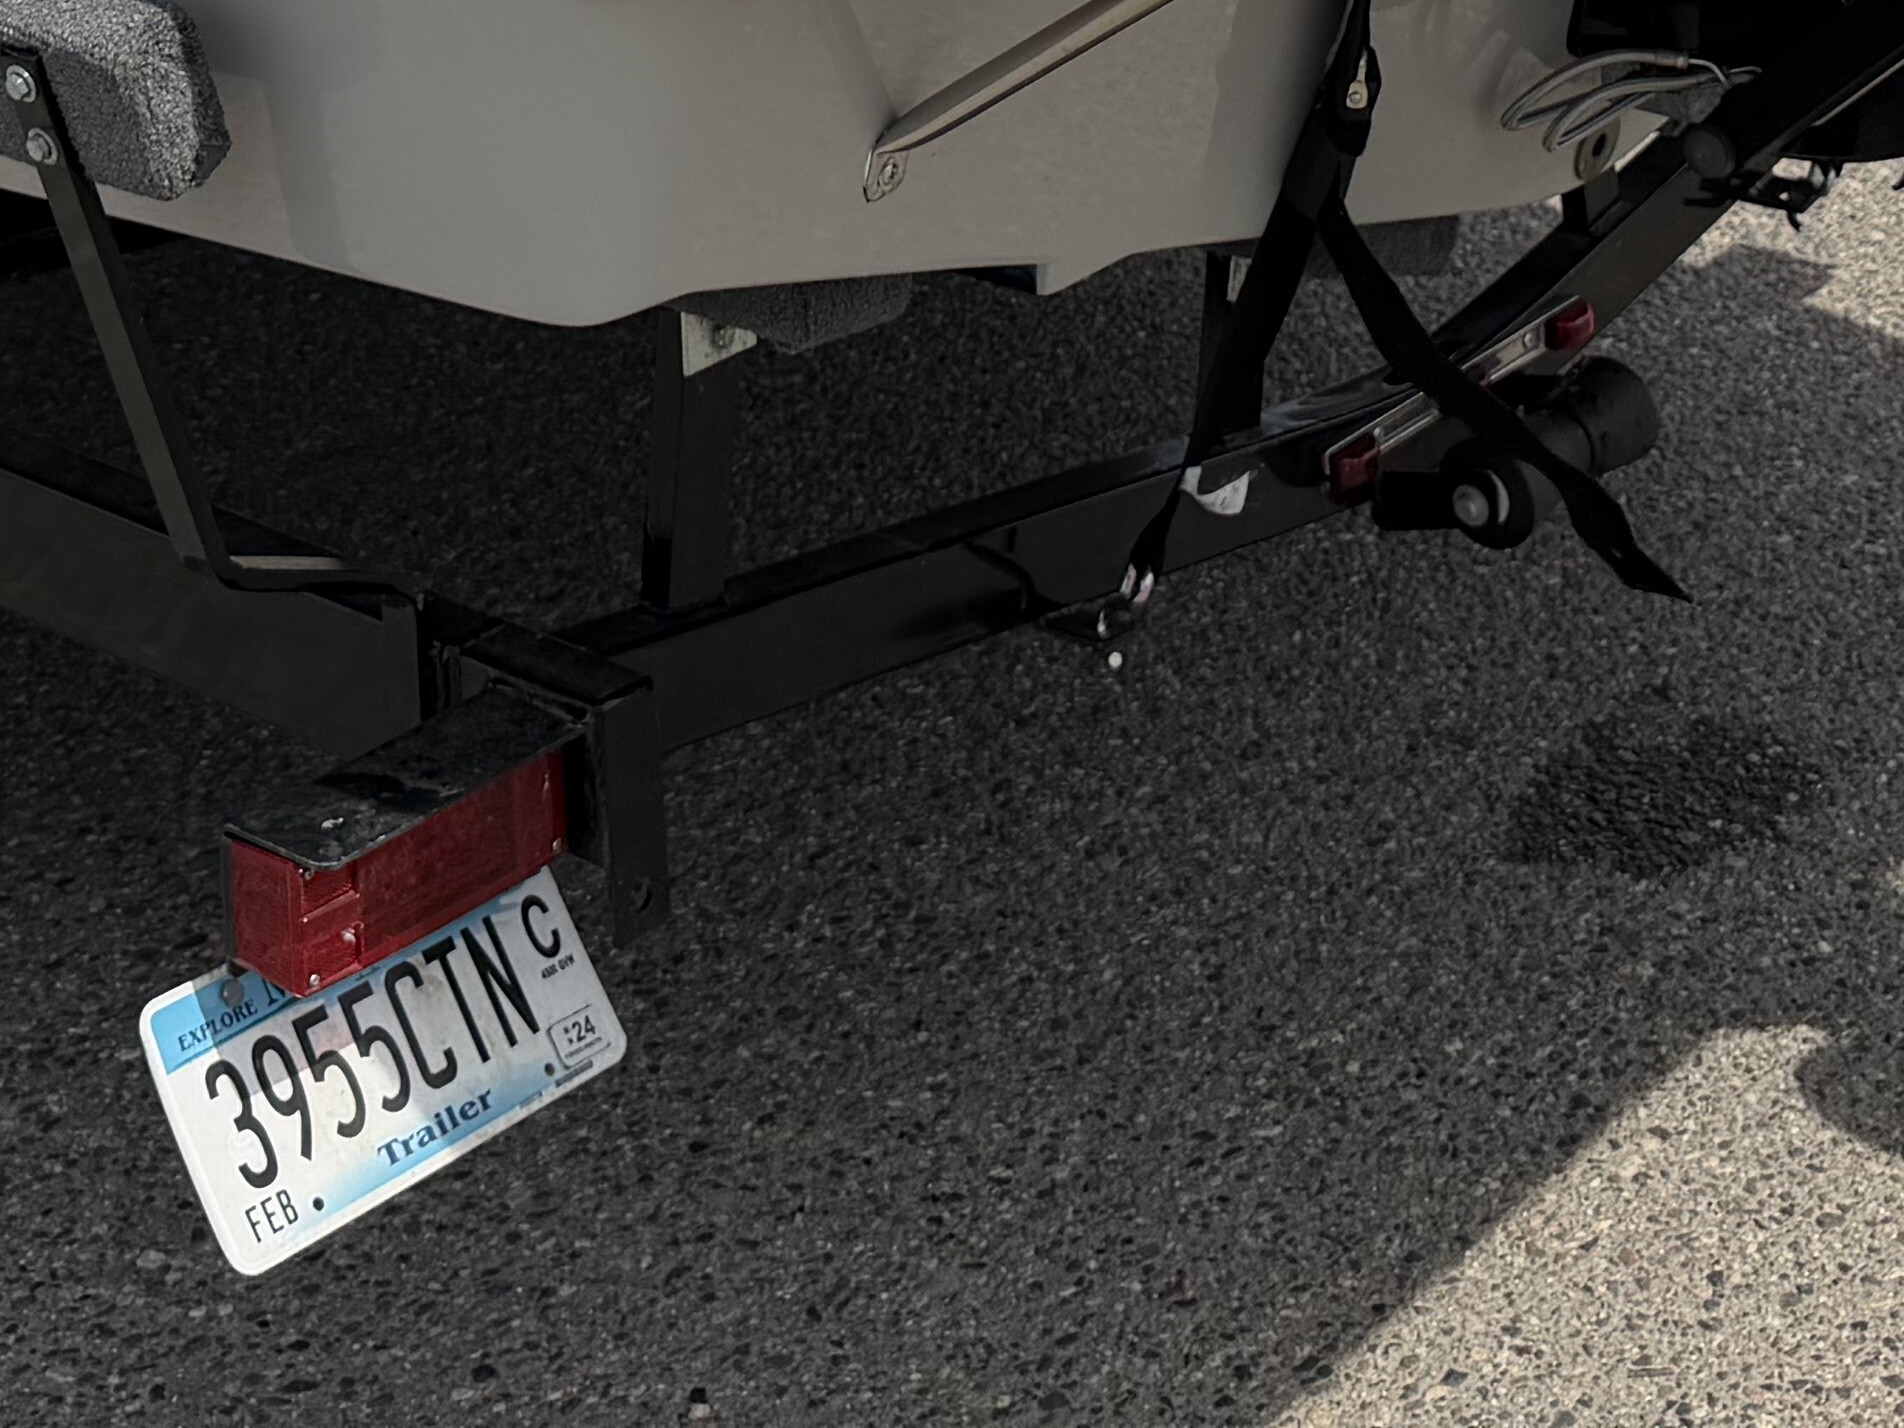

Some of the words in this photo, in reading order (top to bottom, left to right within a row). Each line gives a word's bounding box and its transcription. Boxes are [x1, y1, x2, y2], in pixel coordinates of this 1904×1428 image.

[177, 998, 258, 1052] EXPLORE
[204, 915, 540, 1190] 3955CTN
[519, 893, 563, 959] C
[376, 1088, 495, 1168] Trailer
[243, 1188, 300, 1244] FEB
